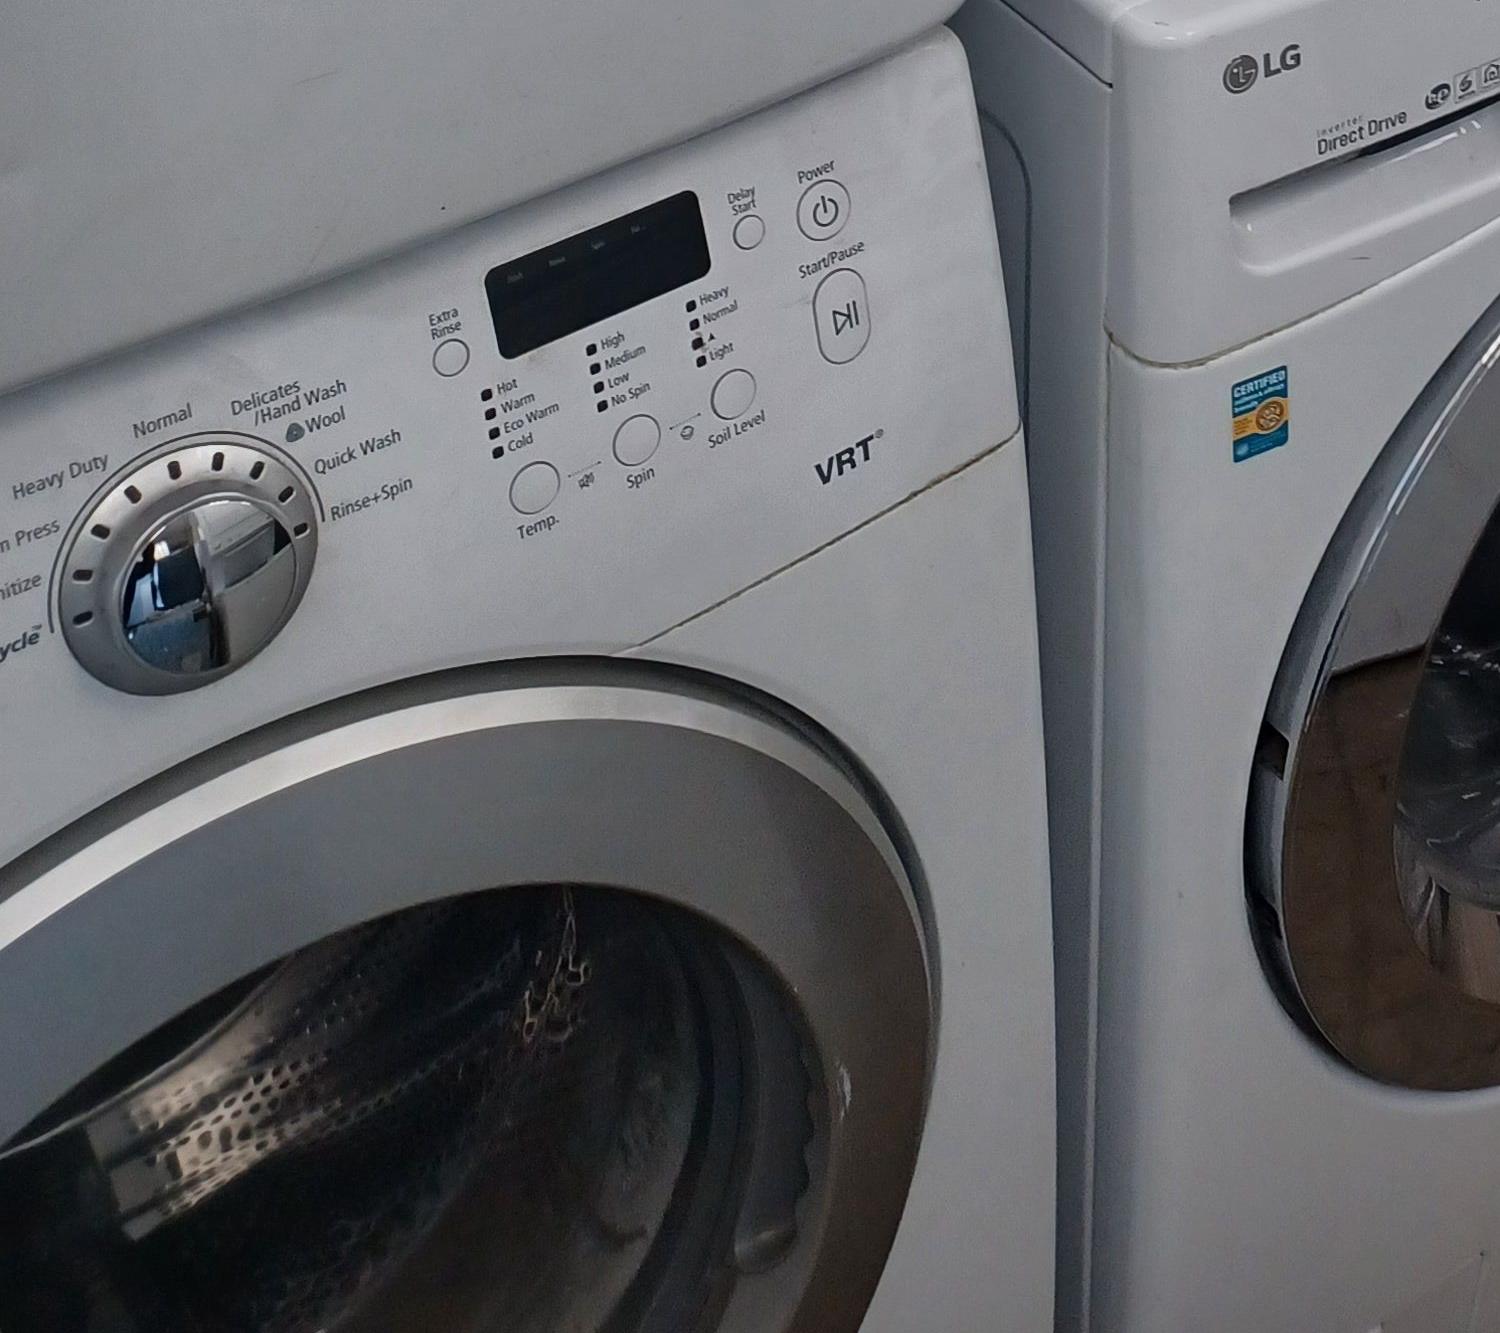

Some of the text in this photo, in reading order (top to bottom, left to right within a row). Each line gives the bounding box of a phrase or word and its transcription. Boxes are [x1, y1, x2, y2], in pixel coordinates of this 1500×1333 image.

[1262, 44, 1302, 79] LG
[1316, 110, 1408, 156] Direct Drive
[797, 160, 835, 184] Power
[727, 186, 756, 205] Delay
[731, 199, 757, 216] Start
[798, 241, 865, 279] Start/Pause
[699, 286, 730, 306] Heavy
[428, 306, 459, 327] Extra
[702, 299, 738, 325] Normal
[431, 320, 462, 341] Rinse
[600, 331, 626, 351] High
[605, 345, 647, 371] Medium
[708, 342, 734, 361] Light
[496, 378, 518, 396] Hot
[607, 372, 631, 390] Low
[1233, 370, 1286, 398] CERTIFIED
[230, 380, 301, 416] Delicates
[254, 379, 348, 426] /Hand Wash
[500, 393, 536, 415] Warm
[611, 381, 652, 408] No Spin
[132, 403, 193, 439] Normal
[304, 406, 347, 435] Wool
[503, 403, 560, 434] Eco Warm
[707, 409, 767, 449] Soil Level
[313, 429, 403, 475] Quick Wash
[507, 432, 535, 452] Cold
[12, 454, 110, 500] Heavy Duty
[626, 466, 656, 490] Spin
[329, 477, 414, 522] Rinse+Spin
[15, 519, 61, 548] Press
[516, 514, 560, 540] Temp.
